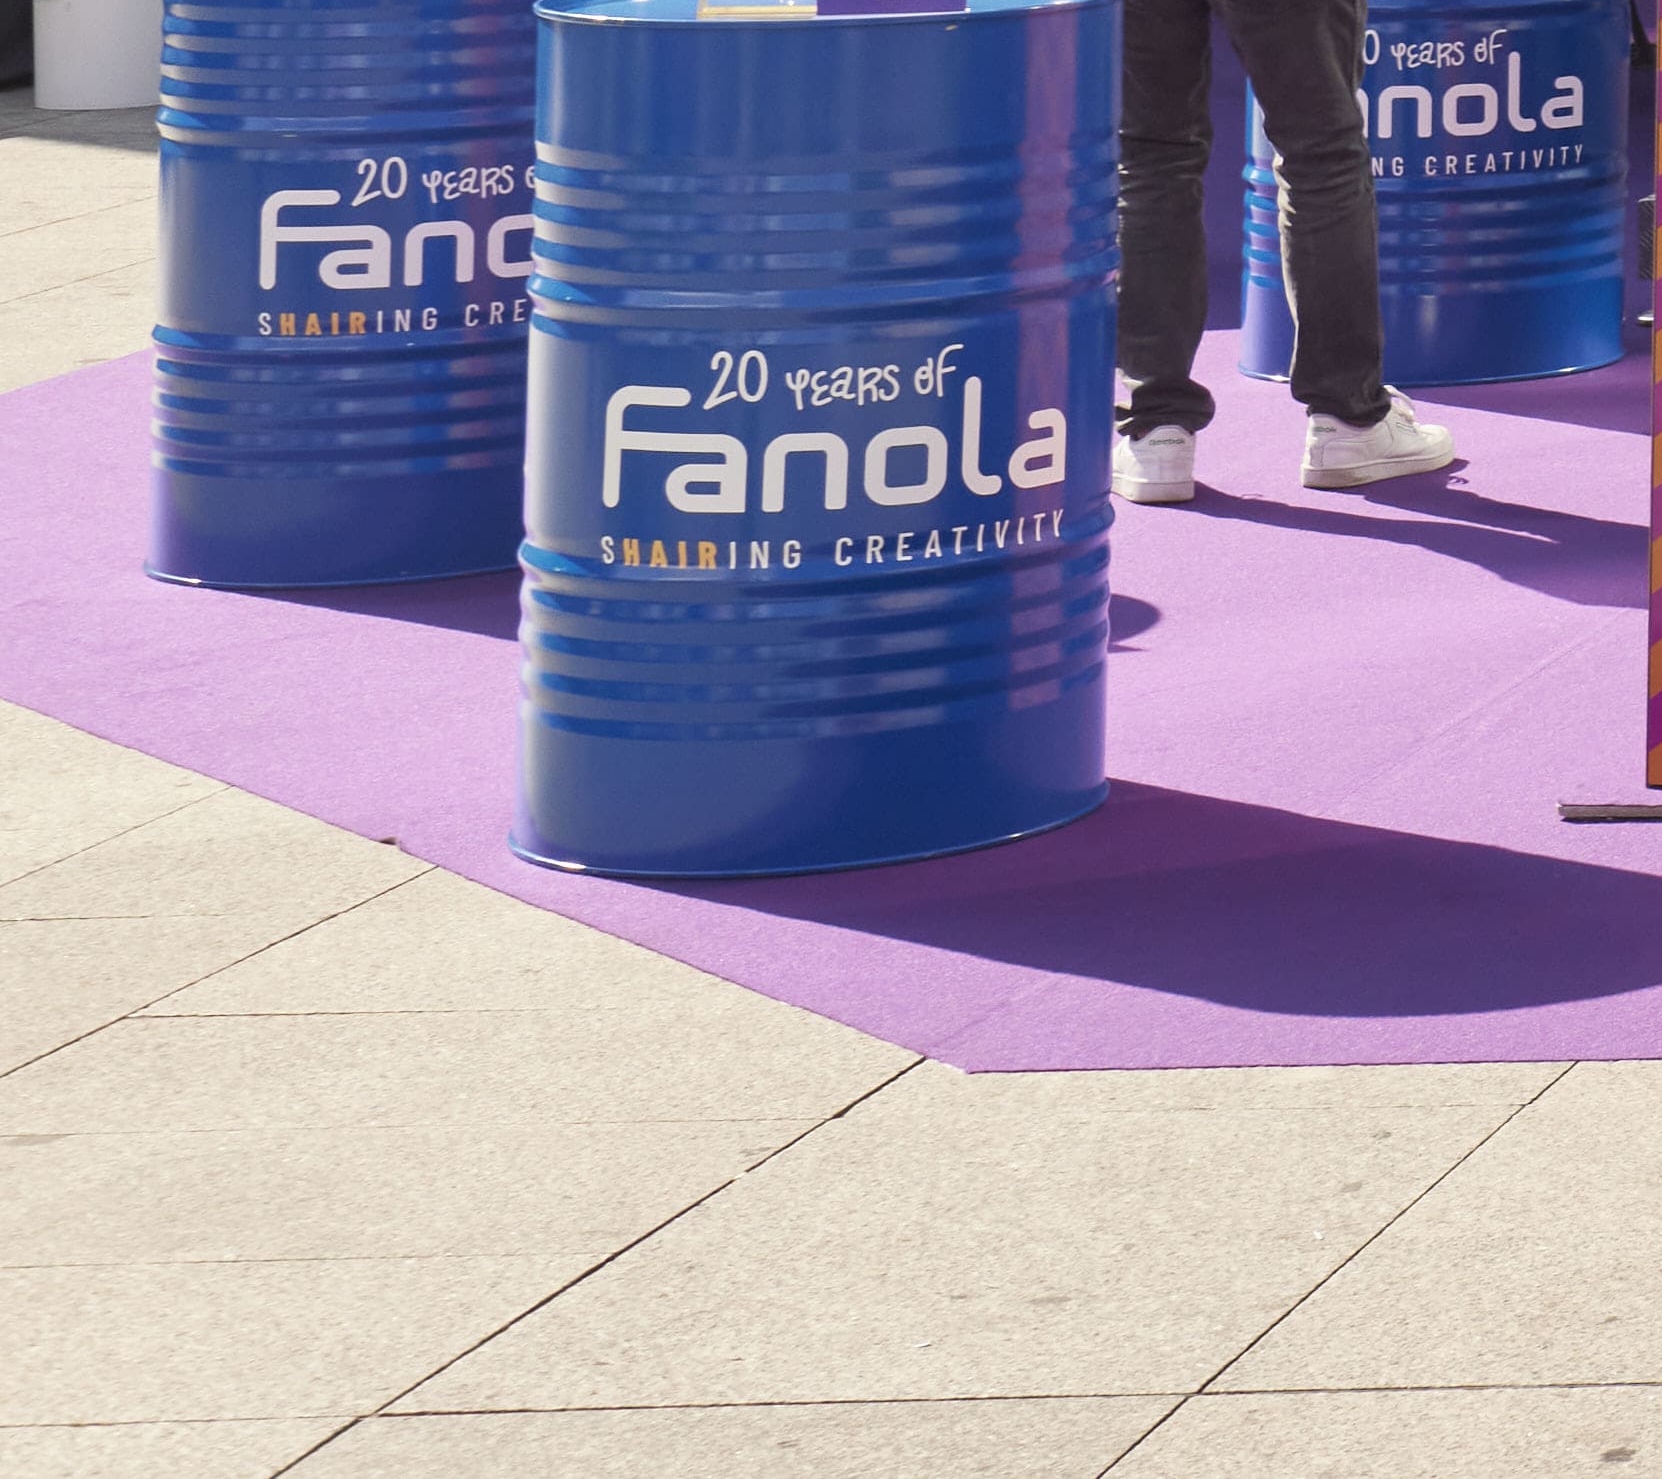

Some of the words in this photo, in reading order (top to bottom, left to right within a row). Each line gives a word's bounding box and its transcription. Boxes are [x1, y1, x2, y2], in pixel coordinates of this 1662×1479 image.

[1355, 50, 1585, 140] nola
[350, 155, 410, 208] 20
[1423, 143, 1585, 177] CREATIVITY
[257, 306, 440, 338] SHAIRING
[702, 348, 769, 413] 20
[600, 374, 1069, 515] Fanola
[600, 531, 804, 572] SHAIRING
[833, 506, 1068, 568] CREATIVITY
